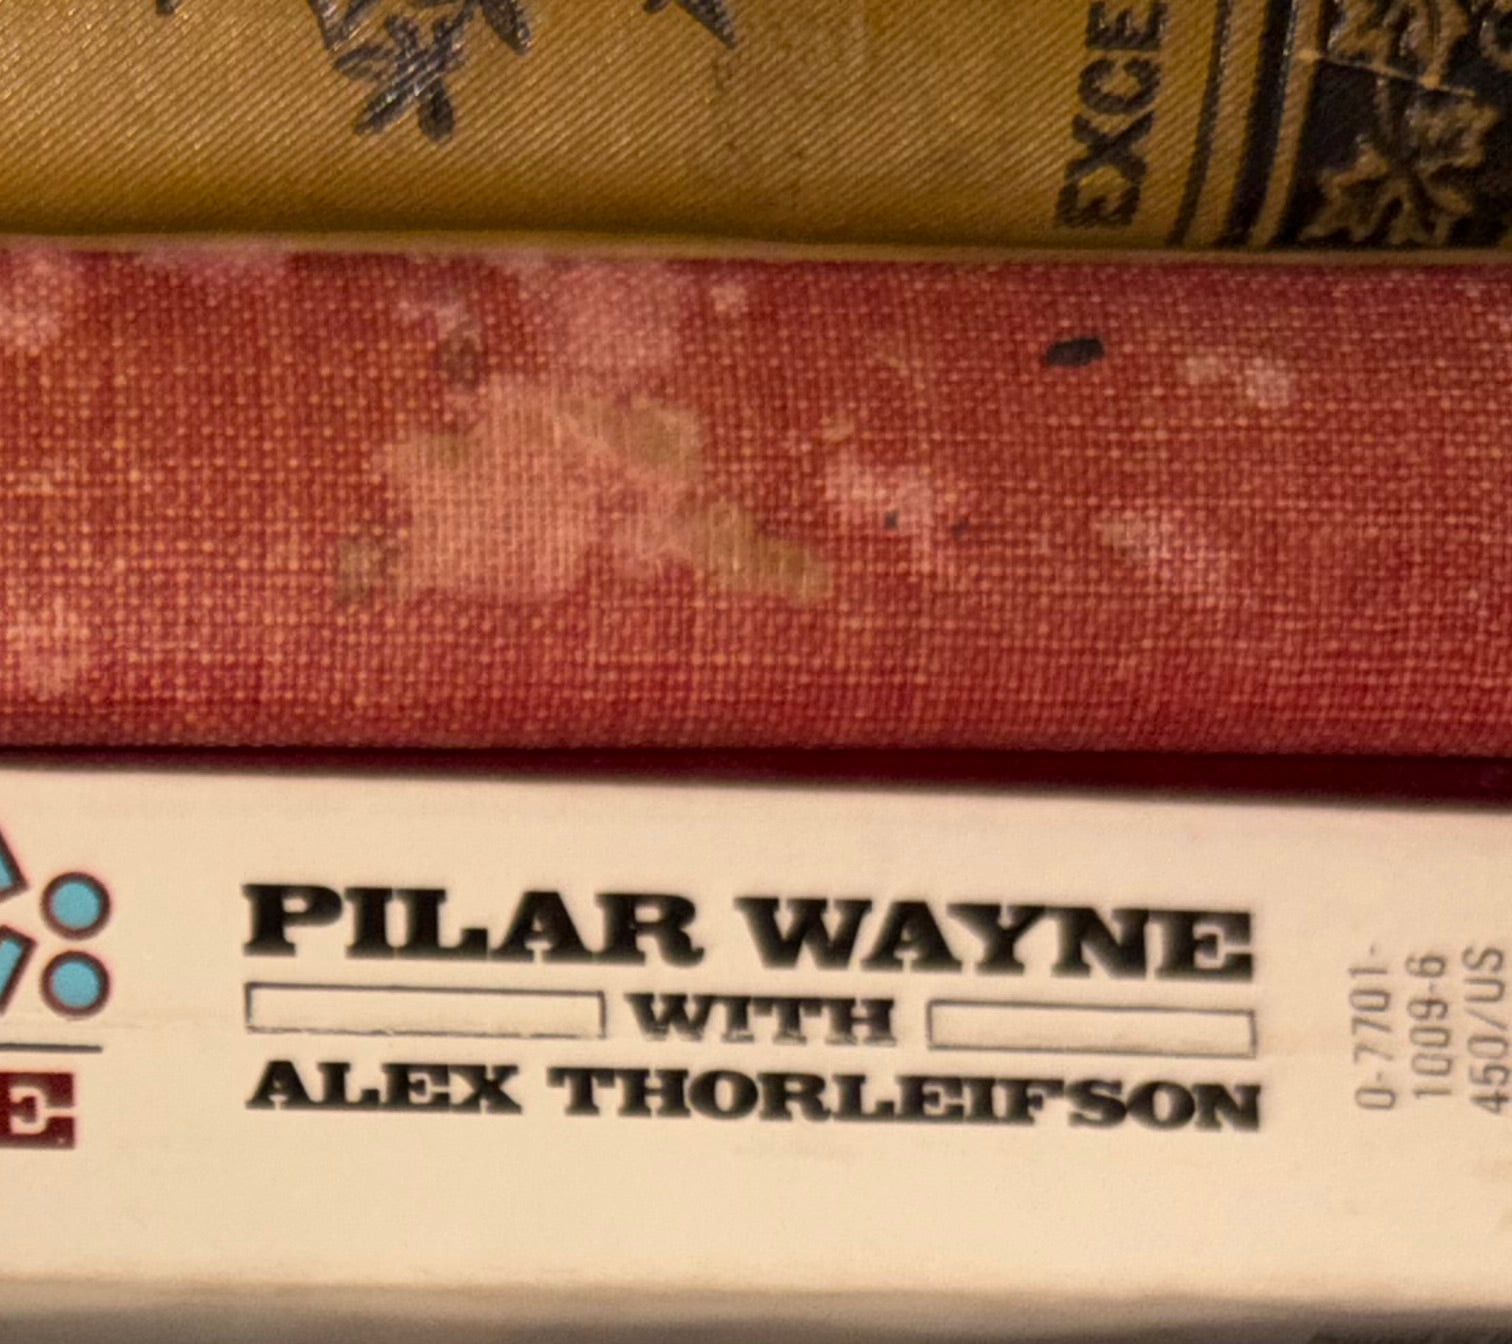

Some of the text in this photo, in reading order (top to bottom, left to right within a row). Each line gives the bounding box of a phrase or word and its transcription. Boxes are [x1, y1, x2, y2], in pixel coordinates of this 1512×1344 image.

[242, 883, 1254, 982] PILAR WAYNE
[624, 992, 895, 1047] WITH
[1349, 944, 1396, 1111] 0-7701-
[1406, 954, 1452, 1100] 1009-6
[1462, 945, 1511, 1114] 450/US
[245, 1058, 1261, 1132] ALEX THORLEIFSON
